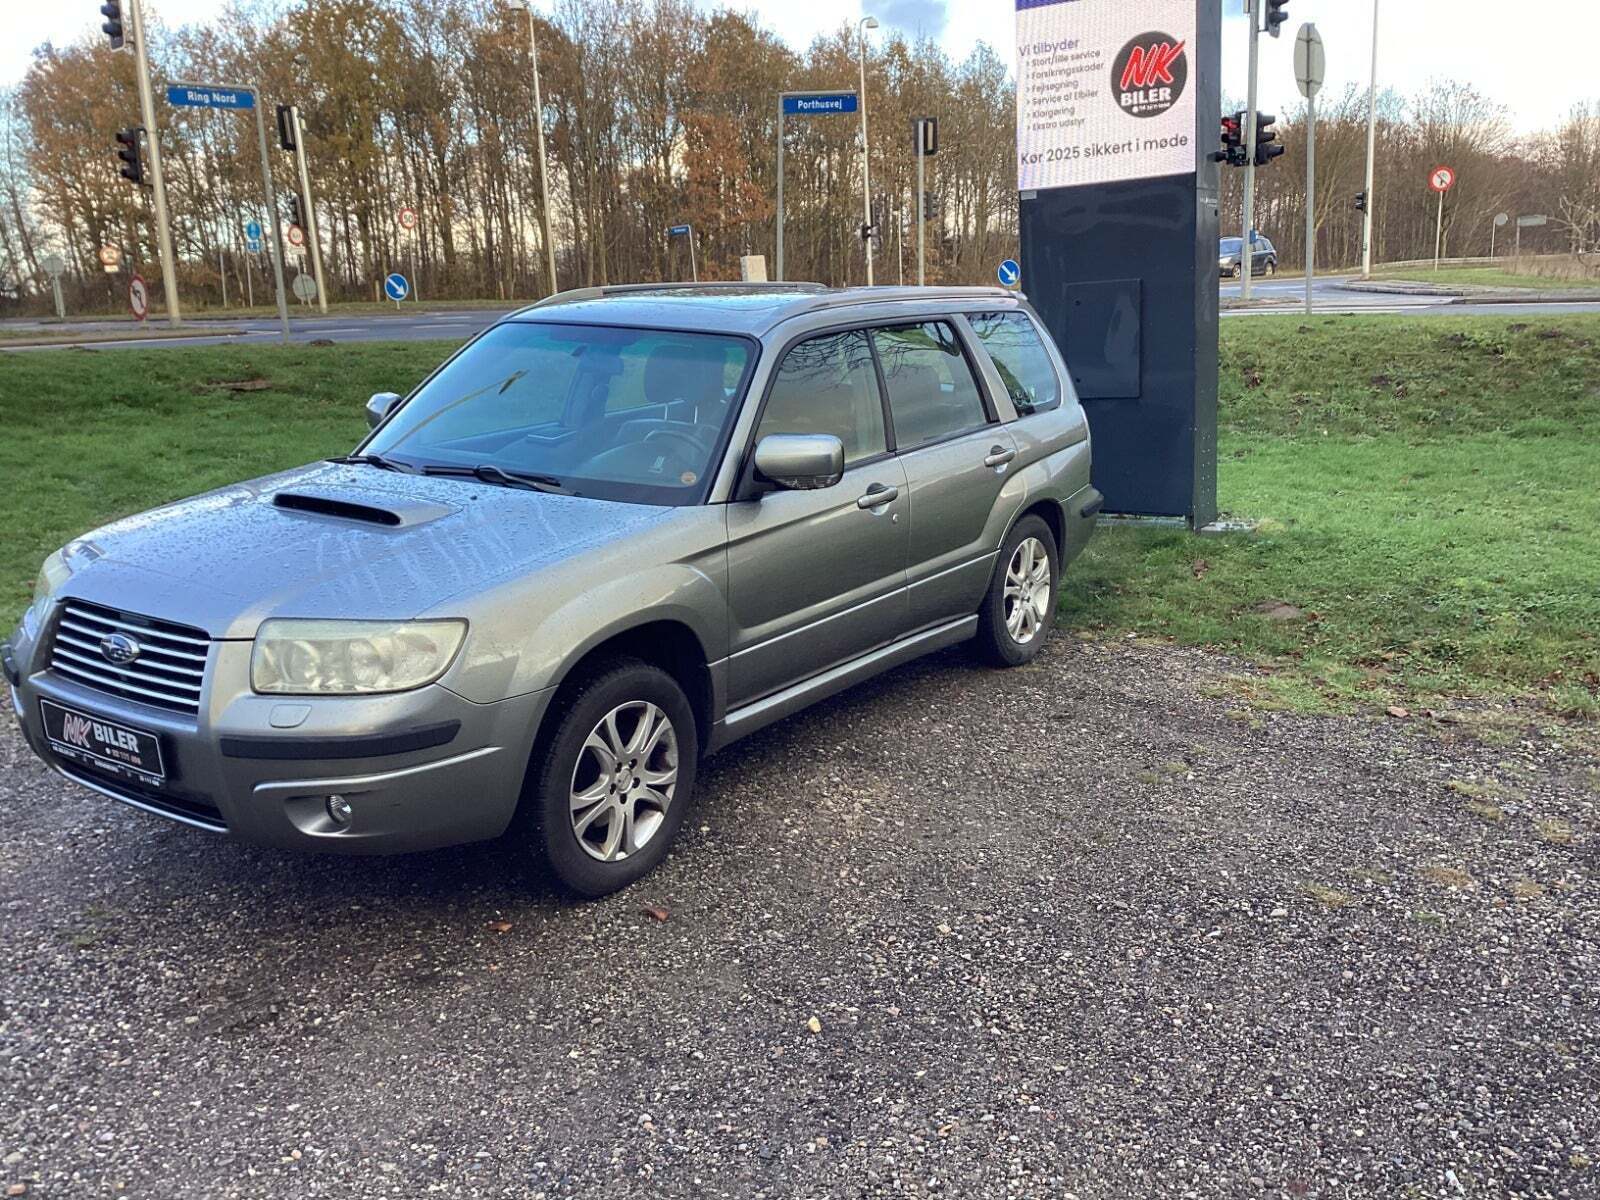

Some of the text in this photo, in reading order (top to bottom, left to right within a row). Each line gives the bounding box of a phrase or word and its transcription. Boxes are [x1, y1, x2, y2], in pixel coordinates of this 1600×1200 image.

[1019, 39, 1079, 57] Vi tilbyder
[1070, 50, 1101, 60] service
[1120, 39, 1186, 91] NK
[187, 90, 237, 104] Ring Nord
[797, 98, 842, 110] Porthusvej
[1031, 95, 1062, 106] Service
[1120, 87, 1172, 106] BILER
[1032, 117, 1086, 132] Ekstra udstyr
[1020, 134, 1188, 166] Kør 2025 sikkert i møde
[63, 712, 92, 749] NK
[92, 722, 140, 754] BILER
